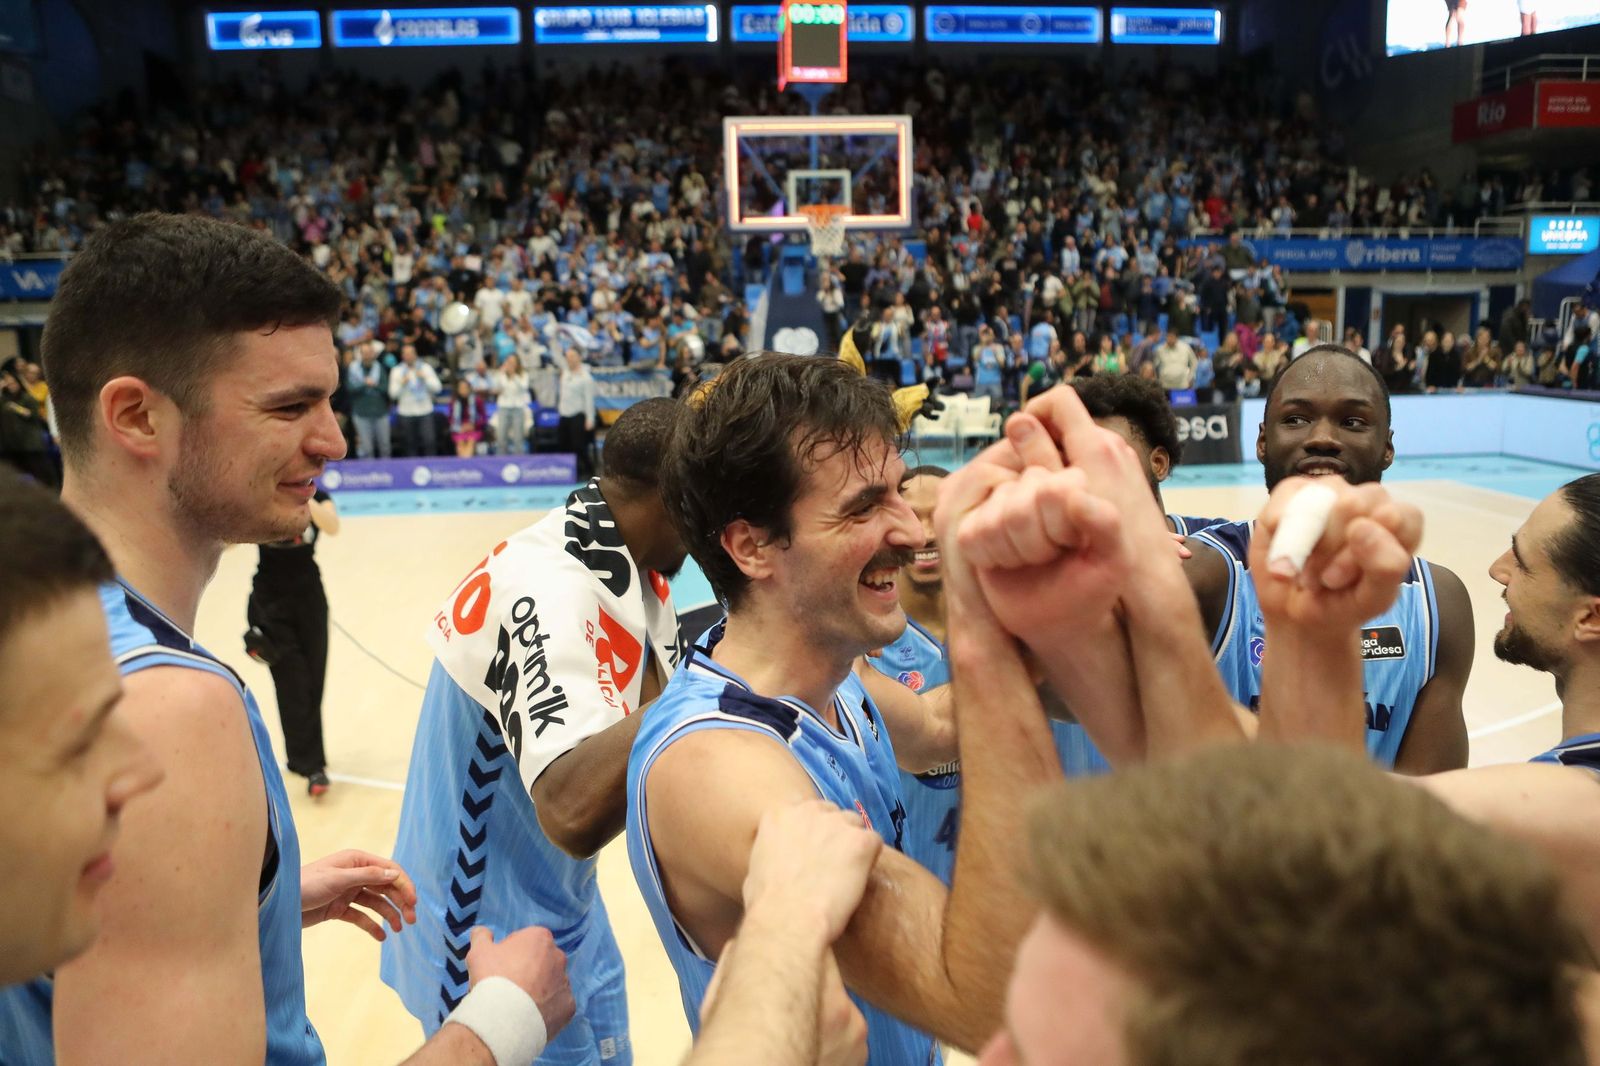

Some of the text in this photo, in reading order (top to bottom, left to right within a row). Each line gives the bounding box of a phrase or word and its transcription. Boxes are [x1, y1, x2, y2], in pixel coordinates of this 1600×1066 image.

[535, 8, 592, 27] GRUPO
[635, 7, 705, 26] IGLESIAS
[787, 3, 845, 24] 00:00
[1477, 102, 1506, 127] Río
[1366, 244, 1421, 263] ribera
[433, 610, 452, 643] ICIA
[1361, 645, 1402, 656] endesa
[511, 596, 570, 739] optimilk
